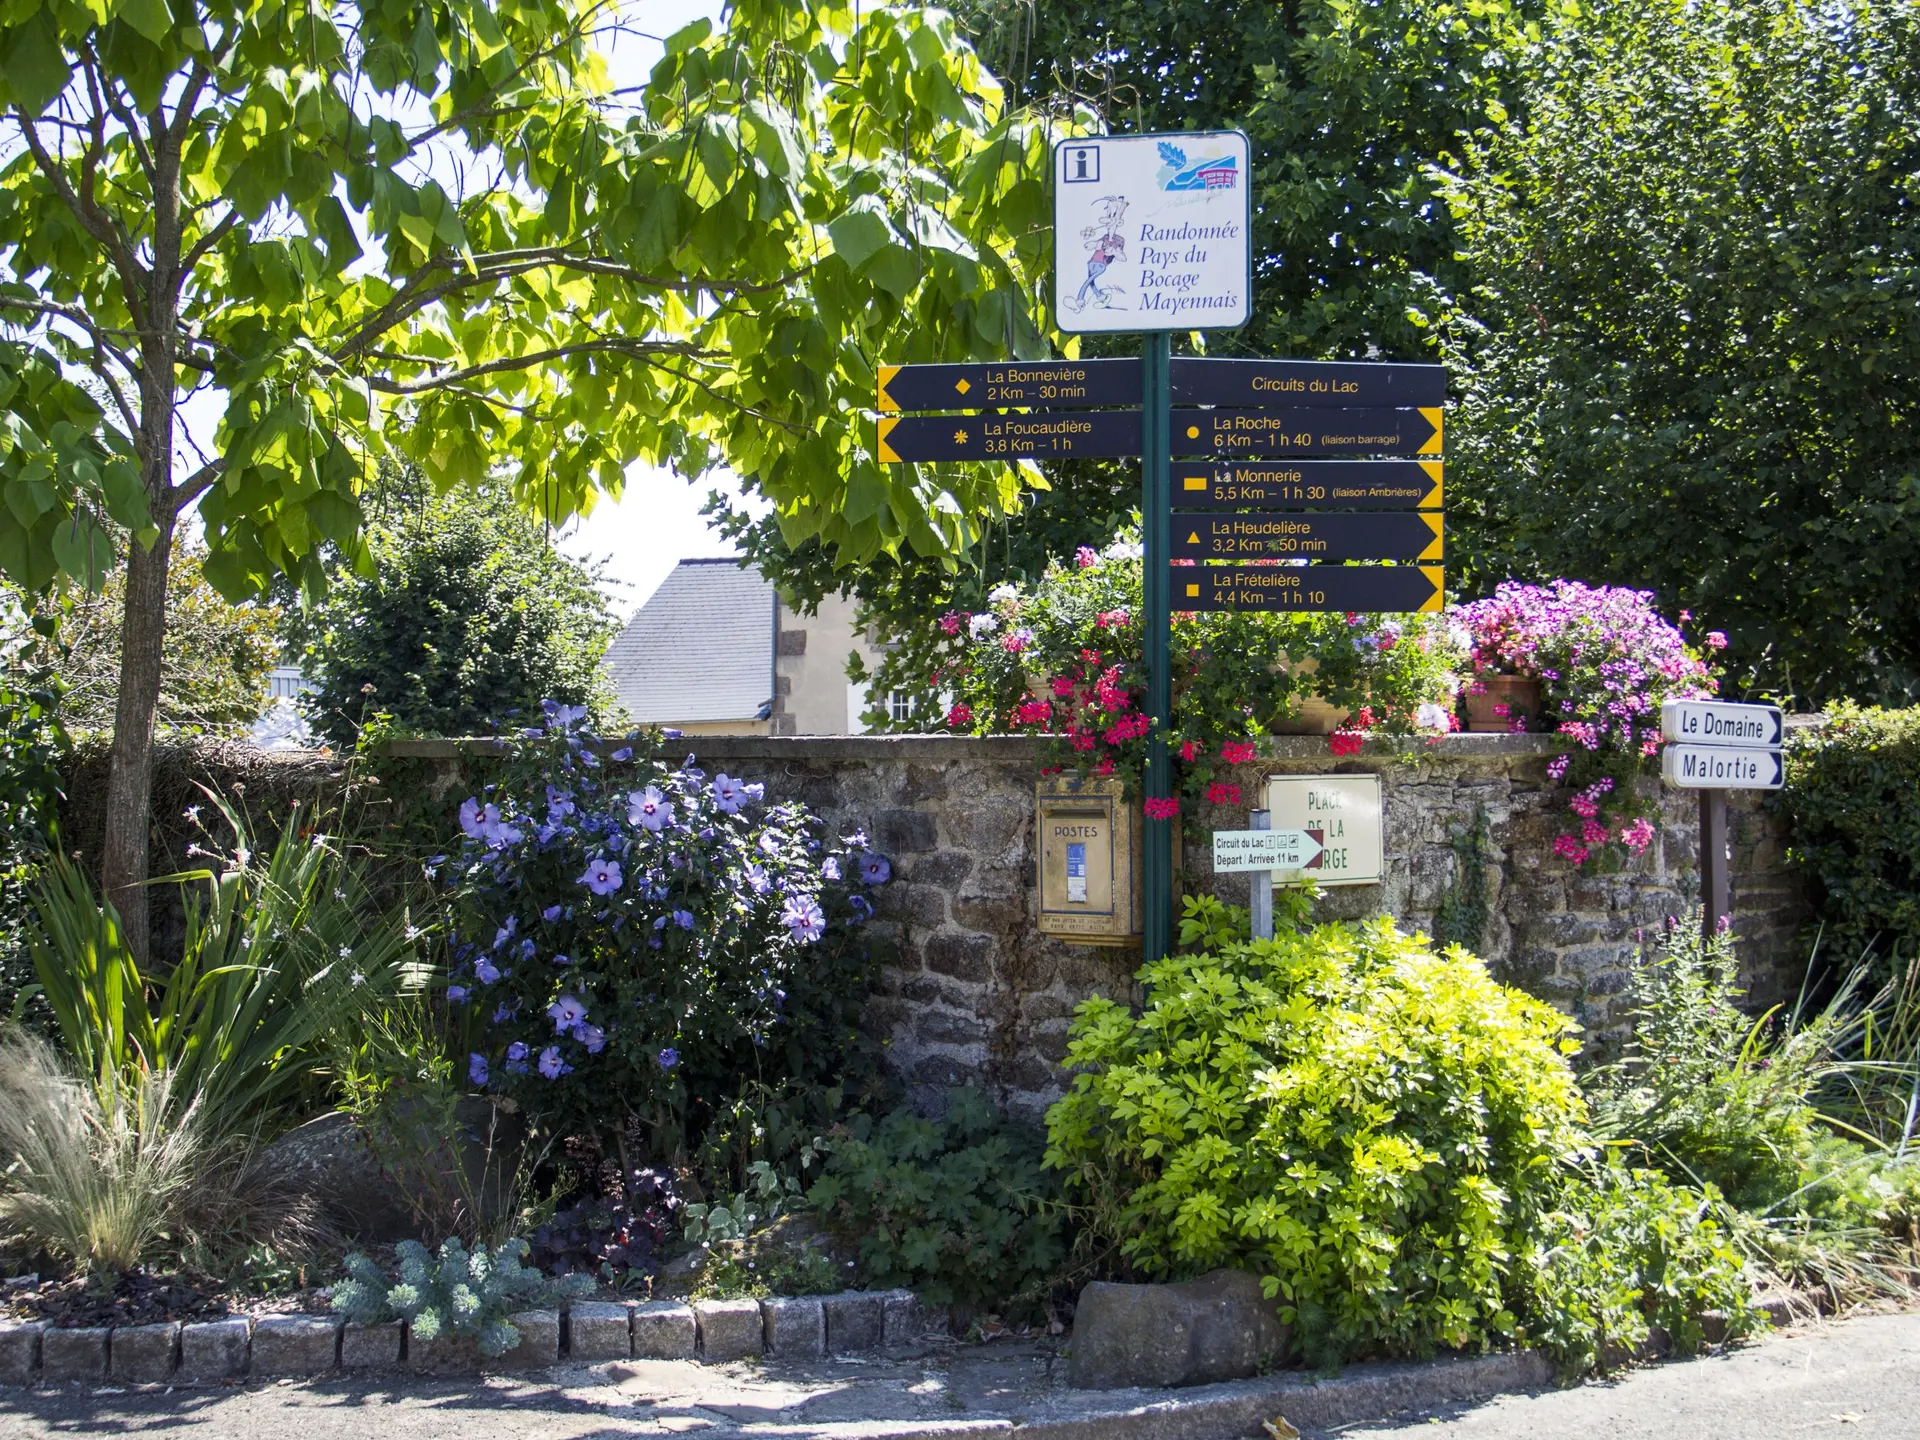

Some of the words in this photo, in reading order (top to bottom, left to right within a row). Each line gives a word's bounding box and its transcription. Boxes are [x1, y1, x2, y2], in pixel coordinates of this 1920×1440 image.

[1139, 221, 1239, 242] Randonnée
[1140, 246, 1178, 269] Pays
[1184, 245, 1207, 264] du
[1139, 270, 1199, 292] Bocage
[1139, 290, 1238, 315] Mayennais
[986, 370, 1004, 383] La
[1008, 368, 1085, 382] Bonnevière
[987, 388, 996, 400] 2
[1000, 387, 1023, 399] Km
[1039, 386, 1056, 399] 30
[1061, 384, 1085, 398] min
[1252, 377, 1305, 392] Circuits
[1310, 379, 1328, 392] du
[1332, 379, 1359, 393] Lac
[984, 423, 1001, 436] La
[1005, 420, 1092, 435] Foucaudière
[1214, 417, 1231, 430] La
[1235, 417, 1281, 430] Roche
[985, 440, 1007, 455] 3,8
[1011, 439, 1034, 452] Km
[1051, 438, 1057, 450] 1
[1063, 437, 1072, 450] h
[1214, 434, 1223, 446] 6
[1227, 434, 1250, 446] Km
[1269, 434, 1275, 446] 1
[1280, 434, 1290, 446] h
[1294, 434, 1311, 446] 40
[1321, 435, 1355, 446] (liaison
[1358, 434, 1400, 446] barrage)
[1214, 469, 1231, 483] La
[1236, 470, 1301, 482] Monnerie
[1214, 487, 1237, 501] 5,5
[1241, 487, 1264, 499] Km
[1283, 487, 1288, 499] 1
[1294, 486, 1303, 499] h
[1307, 486, 1325, 499] 30
[1332, 487, 1366, 498] (liaison
[1368, 487, 1421, 498] Ambrières)
[1212, 521, 1229, 535] La
[1234, 521, 1310, 534] Heudelière
[1212, 539, 1235, 552] 3,2
[1239, 539, 1262, 551] Km
[1279, 539, 1296, 551] 50
[1301, 538, 1326, 551] min
[1213, 573, 1231, 586] La
[1235, 573, 1300, 586] Frételière
[1214, 591, 1236, 604] 4,4
[1240, 591, 1263, 603] Km
[1282, 591, 1288, 603] 1
[1294, 591, 1303, 603] h
[1308, 591, 1325, 603] 10
[1682, 710, 1697, 733] Le
[1704, 712, 1763, 738] Domaine
[1683, 754, 1757, 779] Malortie
[1054, 826, 1098, 838] POSTES
[1330, 819, 1344, 837] LA
[1216, 838, 1240, 849] Circuit
[1241, 839, 1250, 848] du
[1252, 837, 1264, 848] Lac
[1216, 854, 1242, 867] Départ
[1248, 853, 1275, 864] Arrivée
[1277, 853, 1286, 863] 11
[1288, 852, 1299, 863] km
